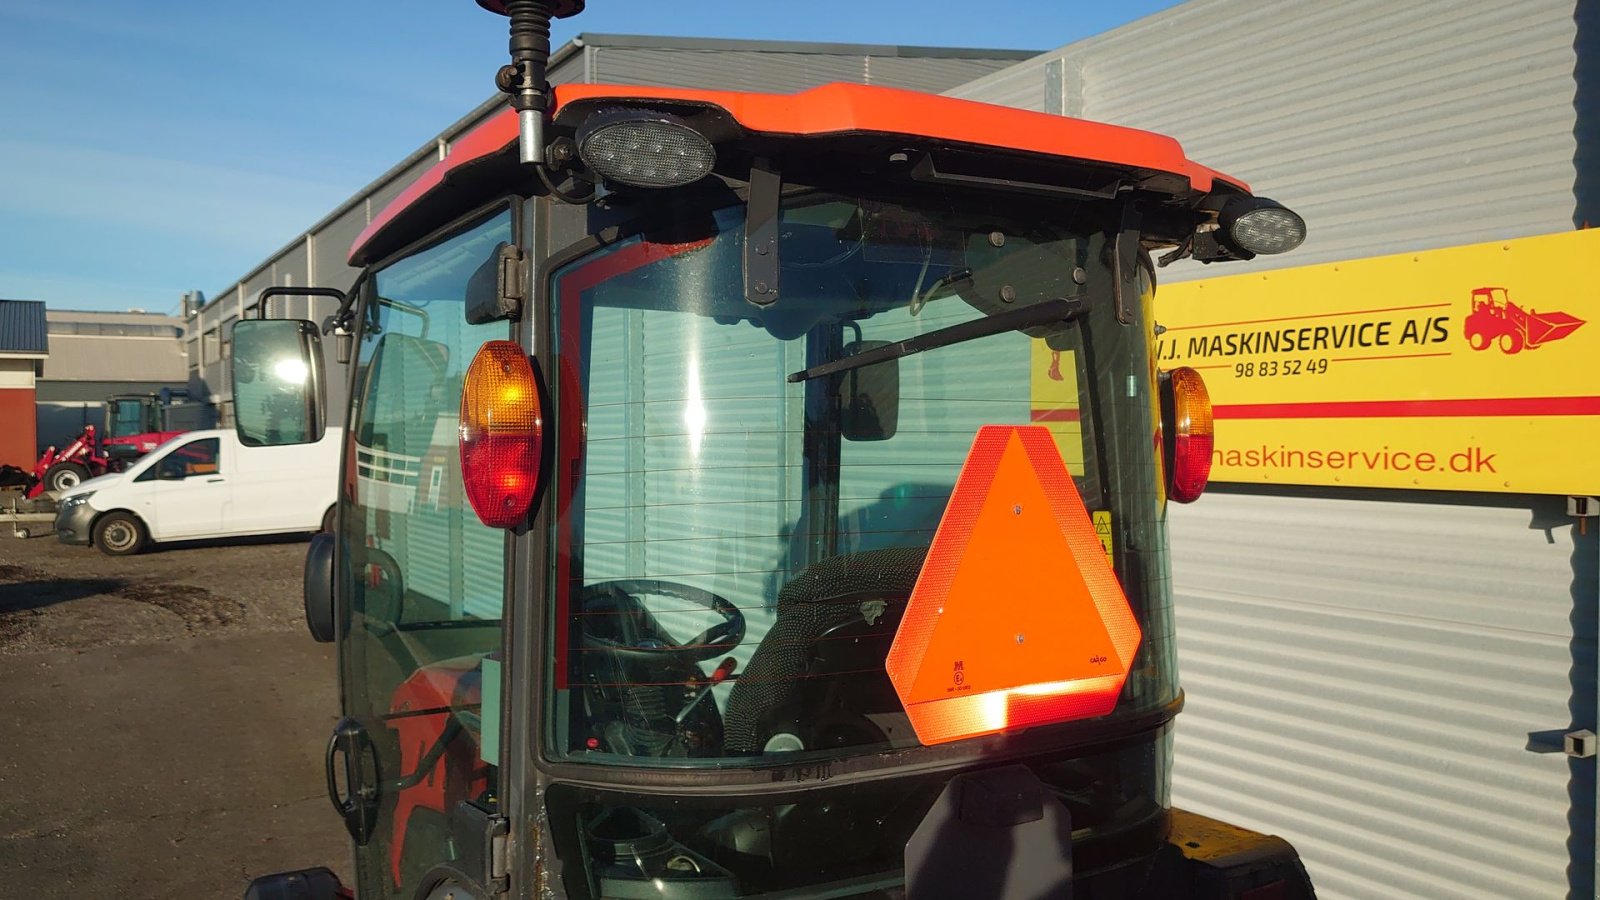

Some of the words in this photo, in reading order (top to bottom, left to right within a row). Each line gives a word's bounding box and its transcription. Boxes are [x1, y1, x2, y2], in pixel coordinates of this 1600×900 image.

[1187, 321, 1392, 358] MASKINSERVICE
[1398, 316, 1450, 345] A/S
[1235, 363, 1254, 378] 98
[1258, 361, 1278, 377] 83
[1282, 360, 1302, 375] 52
[1306, 358, 1328, 374] 49
